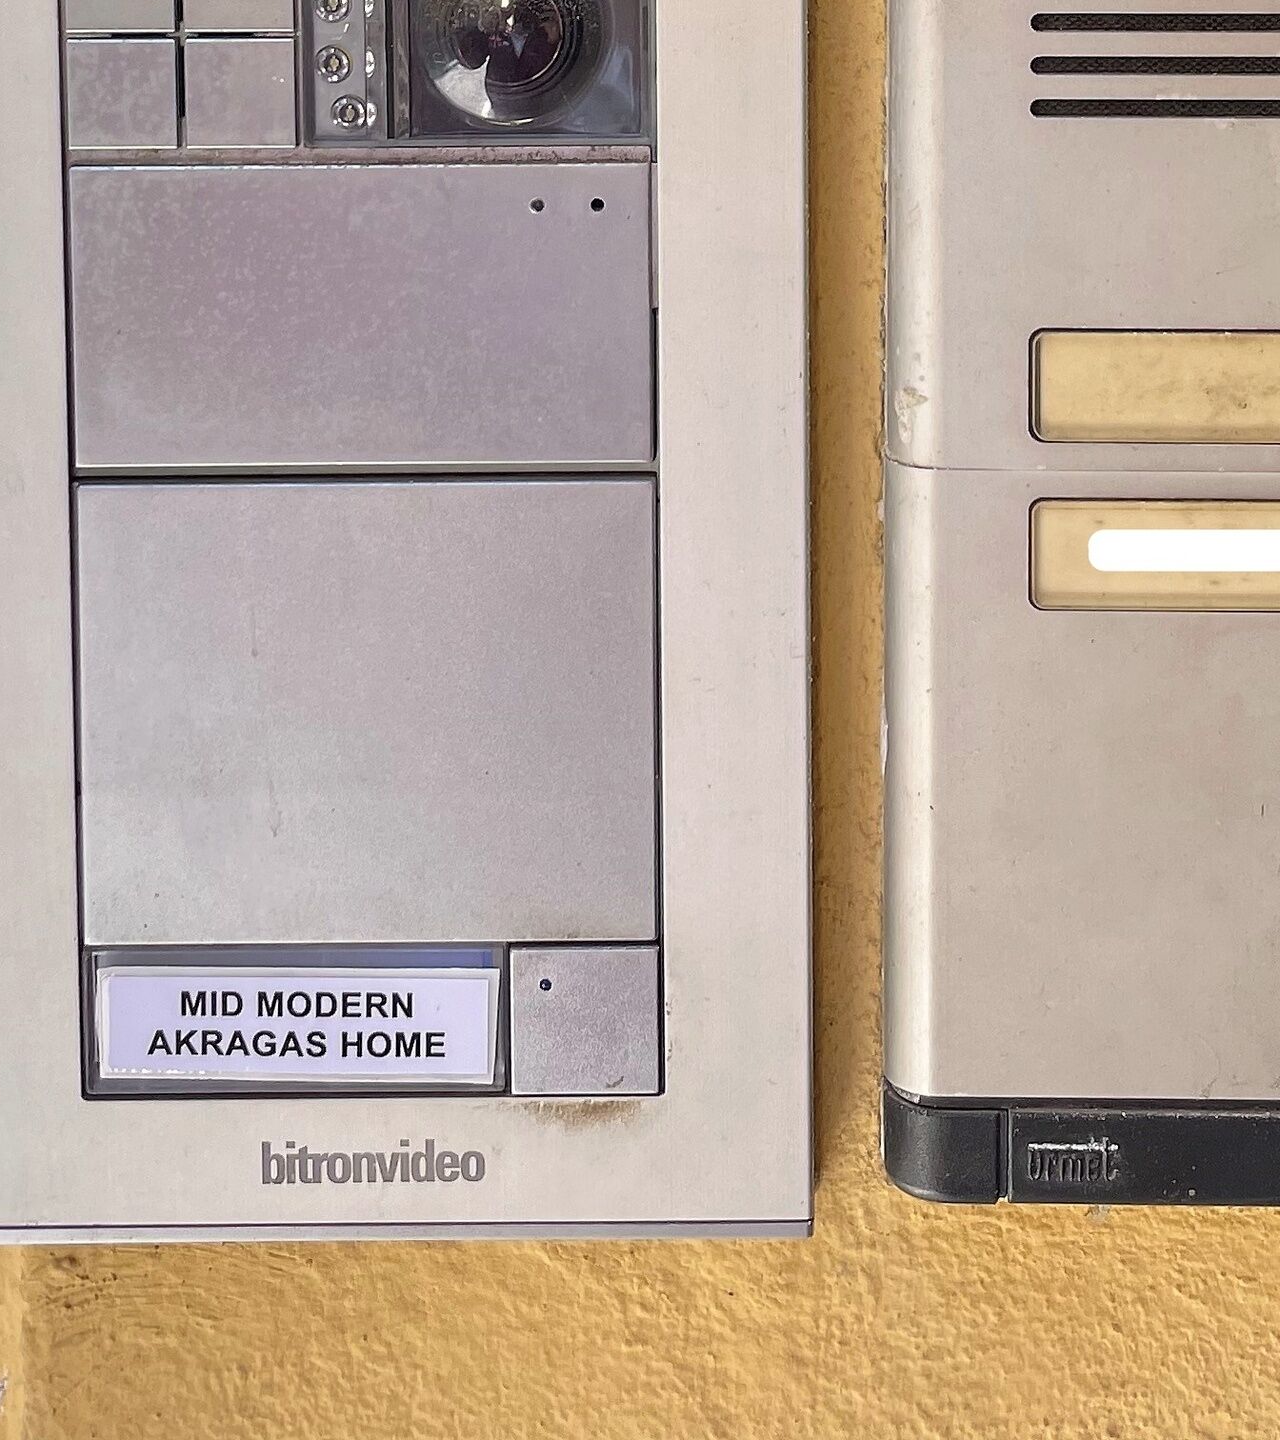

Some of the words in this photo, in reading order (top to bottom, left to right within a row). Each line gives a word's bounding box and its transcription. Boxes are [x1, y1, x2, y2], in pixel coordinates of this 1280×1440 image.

[180, 990, 244, 1017] MID
[257, 991, 415, 1018] MODERN
[147, 1030, 327, 1057] AKRAGAS
[341, 1032, 446, 1058] HOME
[261, 1139, 486, 1185] bitronvideo
